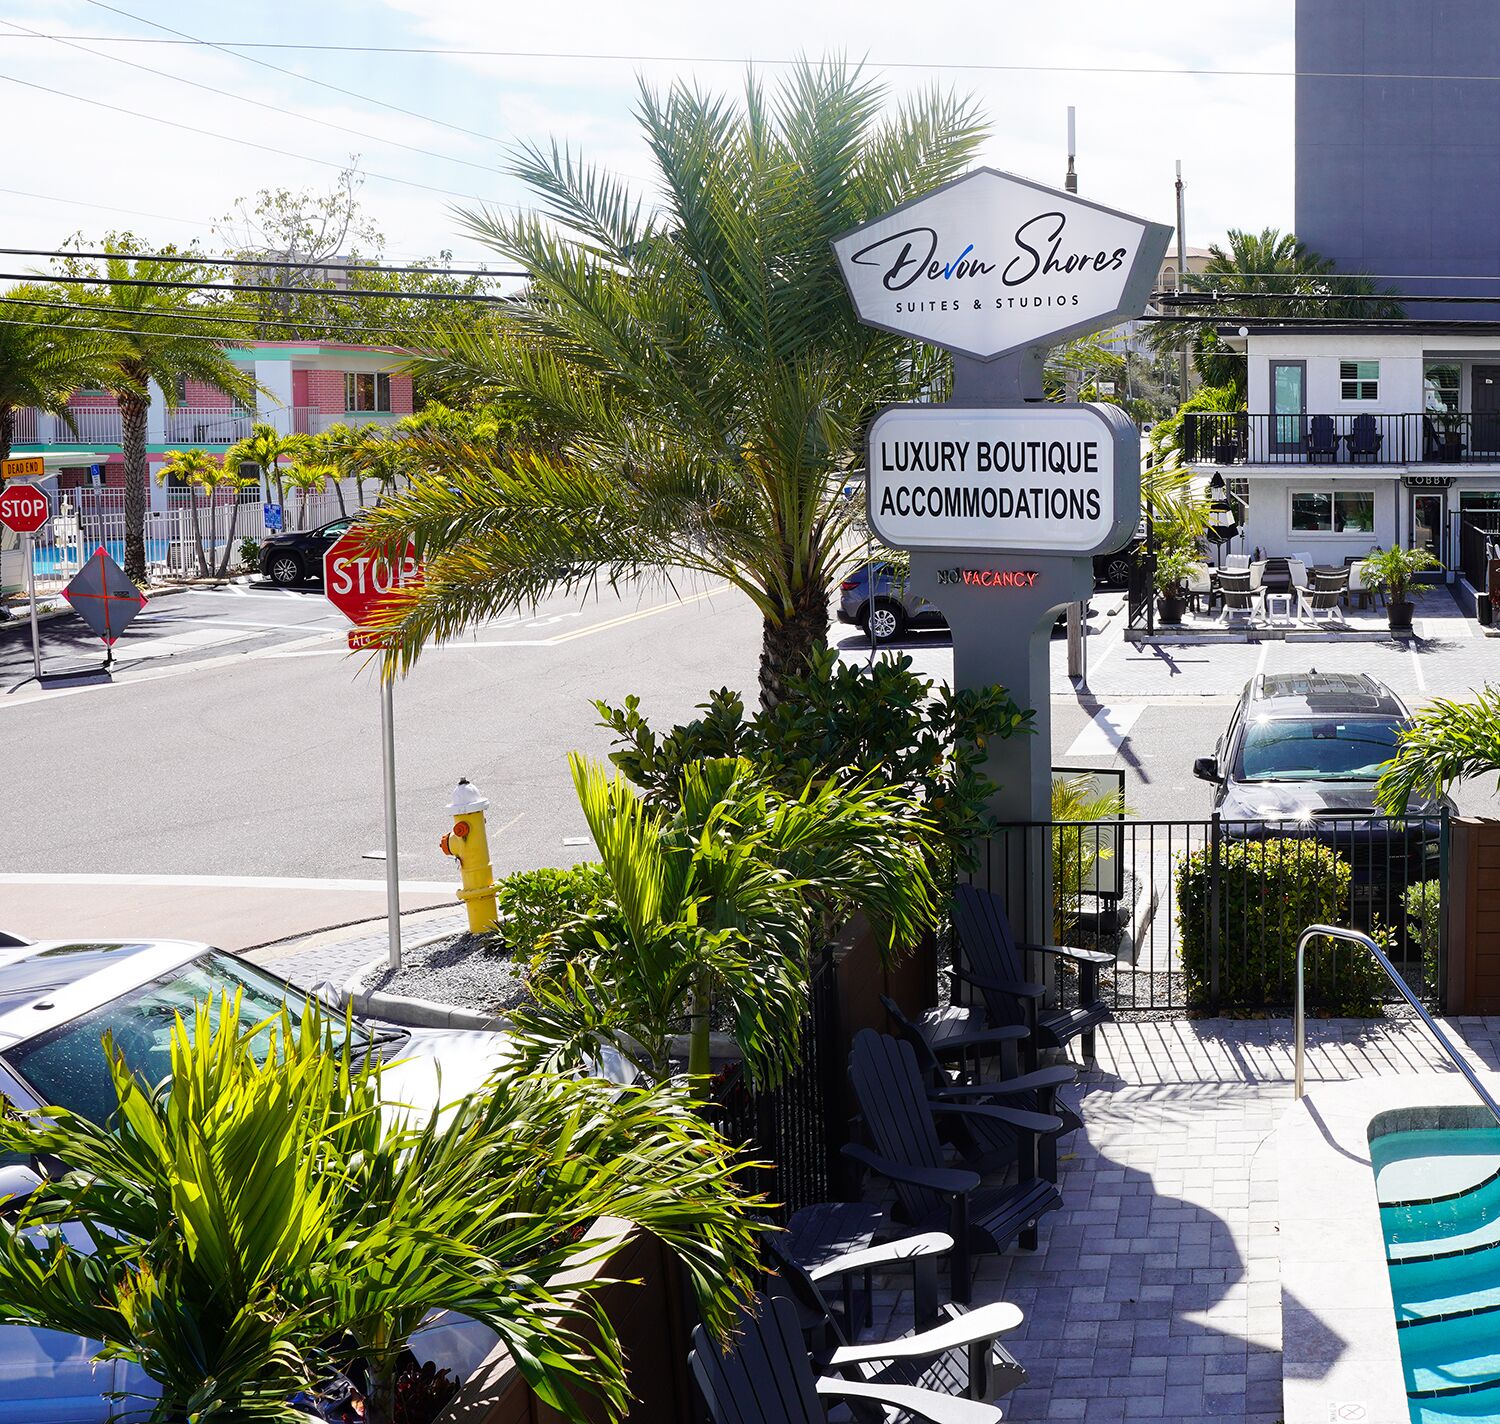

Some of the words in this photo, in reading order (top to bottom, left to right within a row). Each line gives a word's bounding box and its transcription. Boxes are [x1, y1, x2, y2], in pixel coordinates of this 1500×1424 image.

[851, 227, 996, 291] Devon
[1001, 211, 1128, 287] Shores
[895, 299, 960, 313] SUITES
[973, 299, 982, 310] &
[996, 294, 1080, 309] STUDIOS
[881, 441, 971, 472] LUXURY
[976, 441, 1099, 475] BOUTIQUE
[7, 463, 24, 475] DEAD
[25, 461, 39, 472] END
[1408, 476, 1448, 484] LOBBY
[1, 499, 45, 518] STOP
[880, 486, 1101, 520] ACCOMMODATIONS
[332, 557, 418, 595] STOP
[937, 570, 961, 585] NO
[962, 570, 1038, 587] VACANCY
